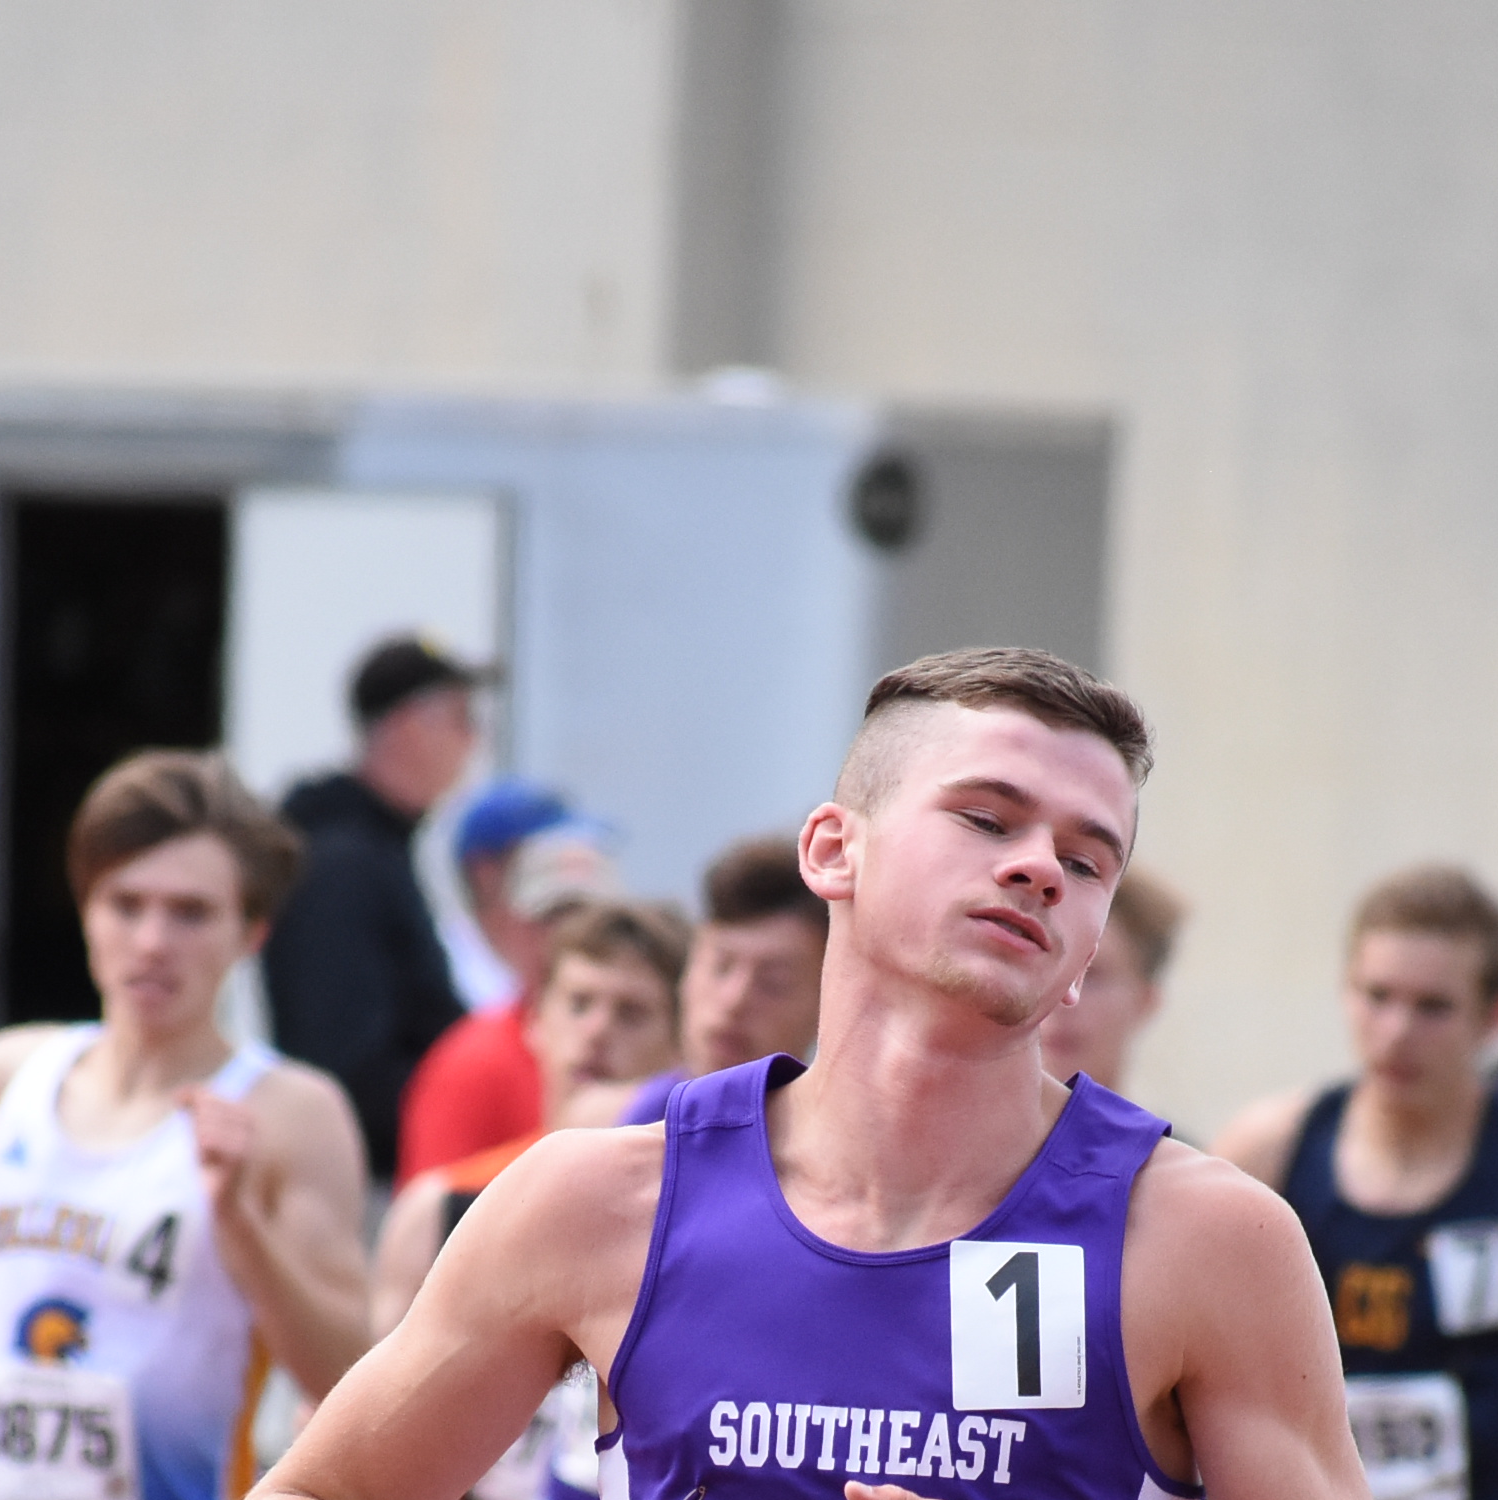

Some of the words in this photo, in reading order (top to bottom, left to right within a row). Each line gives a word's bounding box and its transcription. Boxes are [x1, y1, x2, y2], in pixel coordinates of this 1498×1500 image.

[125, 1210, 181, 1300] 4
[985, 1251, 1042, 1397] 1
[708, 1400, 1026, 1484] SOUTHEAST
